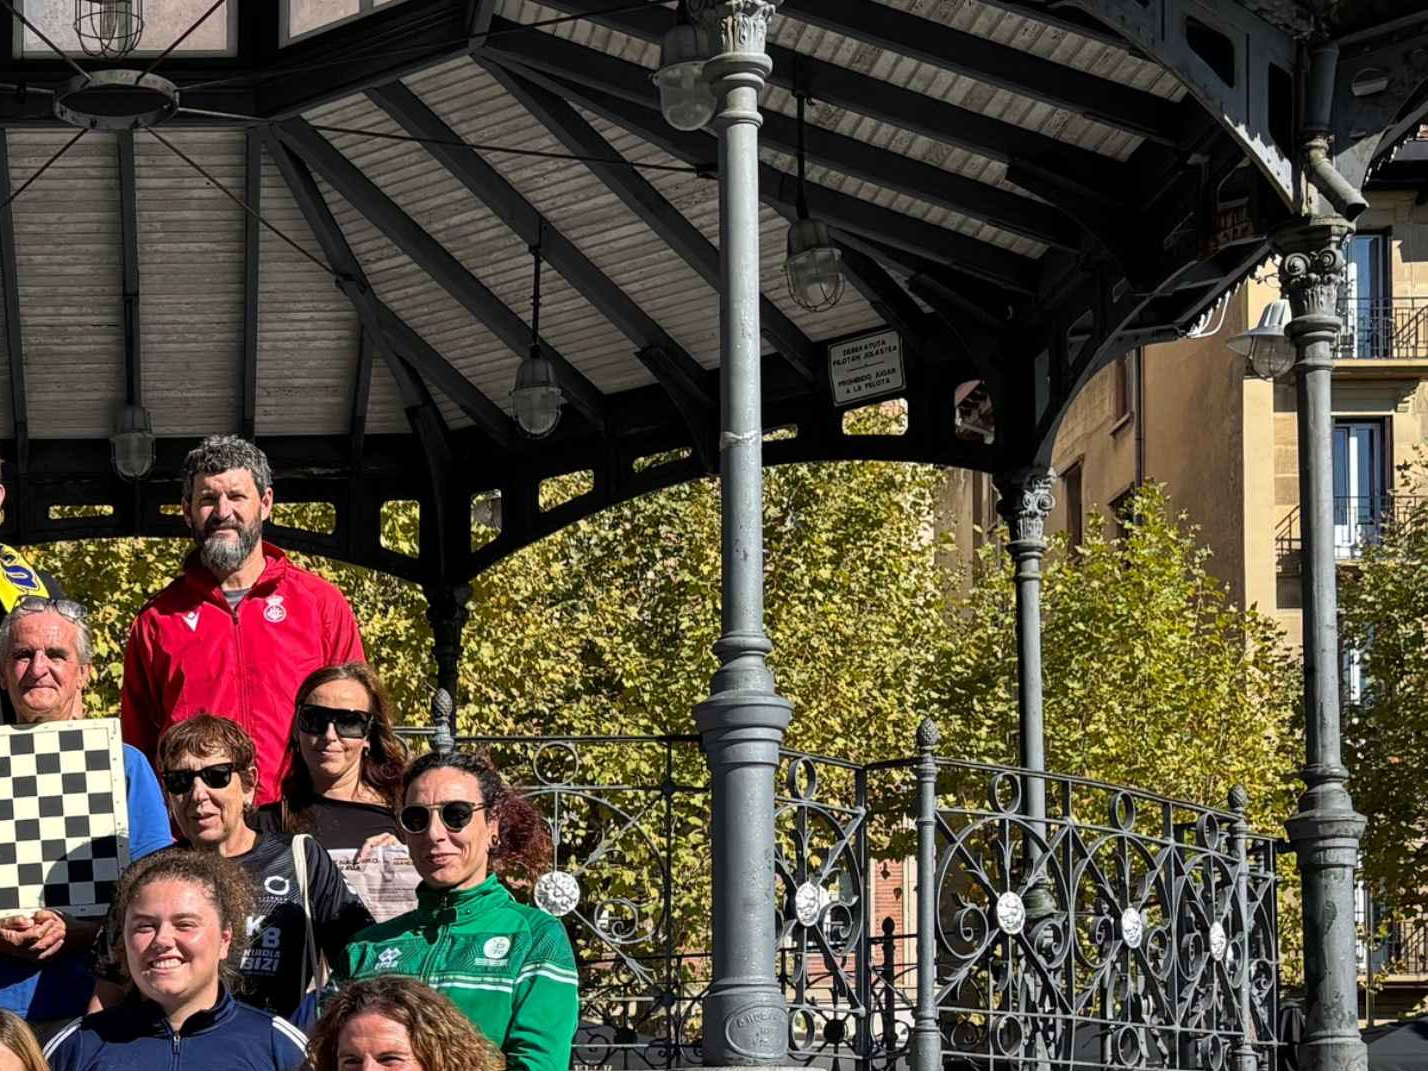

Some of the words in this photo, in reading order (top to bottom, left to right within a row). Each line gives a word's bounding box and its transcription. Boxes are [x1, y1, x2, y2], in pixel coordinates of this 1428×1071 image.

[843, 340, 887, 356] DEBEKATUTA
[833, 355, 861, 366] PILOTAN
[837, 373, 872, 387] PROHIBIDO
[865, 378, 890, 389] PELOTA
